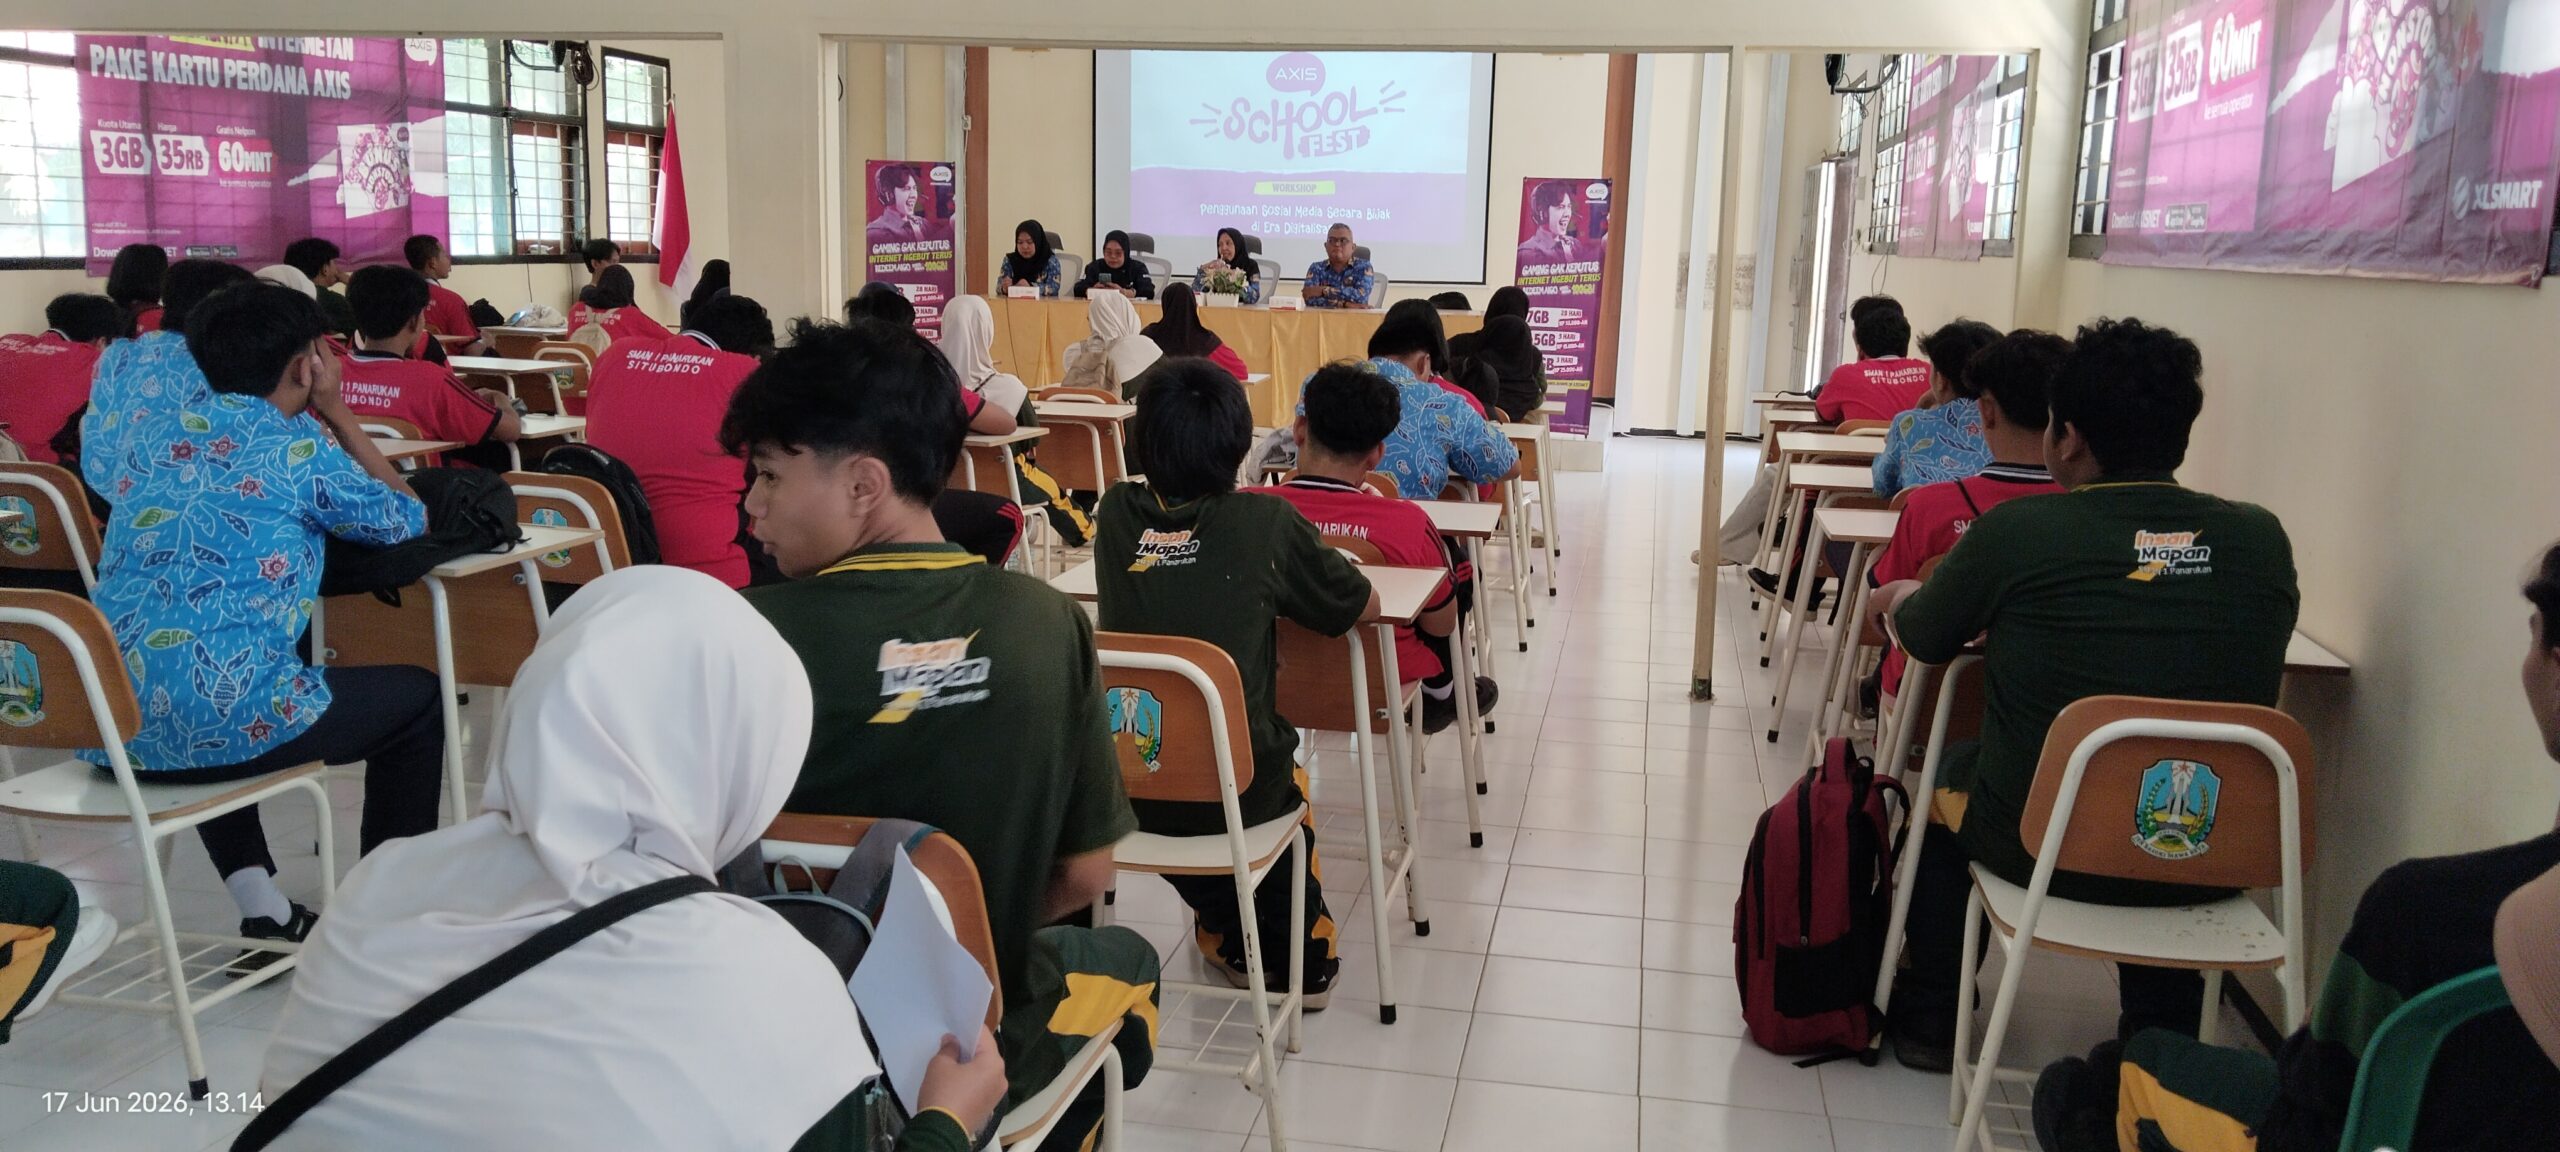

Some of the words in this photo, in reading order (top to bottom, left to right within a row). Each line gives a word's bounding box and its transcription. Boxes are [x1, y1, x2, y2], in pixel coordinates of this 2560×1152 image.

[409, 39, 433, 52] AXIS
[2209, 12, 2262, 86] 60MNT
[90, 44, 148, 81] PAKE
[152, 51, 220, 88] KARTU
[223, 58, 309, 96] PERDANA
[313, 68, 351, 99] AXIS
[1275, 67, 1318, 81] AXIS
[2165, 36, 2198, 101] 35RB
[119, 120, 141, 130] Utama
[1223, 85, 1378, 160] SCHOOL
[1308, 129, 1362, 155] FEST
[100, 136, 145, 169] 3GB
[160, 139, 204, 171] 35RB
[218, 141, 272, 173] 60MNT
[1272, 183, 1317, 193] WORKSHOP
[2472, 180, 2543, 210] XLSMART
[1200, 203, 1258, 217] Penggunaan
[1262, 204, 1291, 217] Sosial
[1295, 204, 1323, 217] Media
[1327, 206, 1362, 219] Secara
[1366, 207, 1391, 221] Bijak
[1251, 221, 1260, 232] di
[1264, 222, 1280, 233] Era
[1284, 221, 1329, 234] Digitalisa
[93, 246, 121, 257] Down
[872, 243, 900, 254] GAMING
[901, 242, 917, 253] GAK
[917, 240, 950, 251] KEPUTUS
[869, 253, 902, 263] INTERNET
[903, 252, 930, 261] NGEBUT
[931, 251, 952, 259] TERUS
[1522, 264, 1550, 276] GAMING
[1550, 263, 1566, 275] GAK
[1566, 261, 1600, 273] KEPUTUS
[1517, 275, 1551, 286] INTERNET
[1551, 274, 1579, 284] NGEBUT
[1579, 272, 1601, 282] TERUS
[1534, 334, 1555, 346] 5GB
[626, 350, 653, 361] SMAN
[660, 352, 714, 366] PANARUKAN
[626, 360, 700, 374] SITUBONDO
[1864, 369, 1883, 377] SMAN
[1871, 375, 1925, 384] SITUBONDO
[352, 382, 400, 398] PANARUKAN
[342, 393, 391, 408] UBONDO
[1315, 521, 1369, 540] NARUKAN
[1953, 519, 1971, 535] SM
[1139, 528, 1192, 544] Insan
[2134, 530, 2194, 549] Insan
[1136, 540, 1200, 559] Mapan
[2138, 546, 2211, 567] Mapan
[2169, 566, 2212, 575] Panarukan
